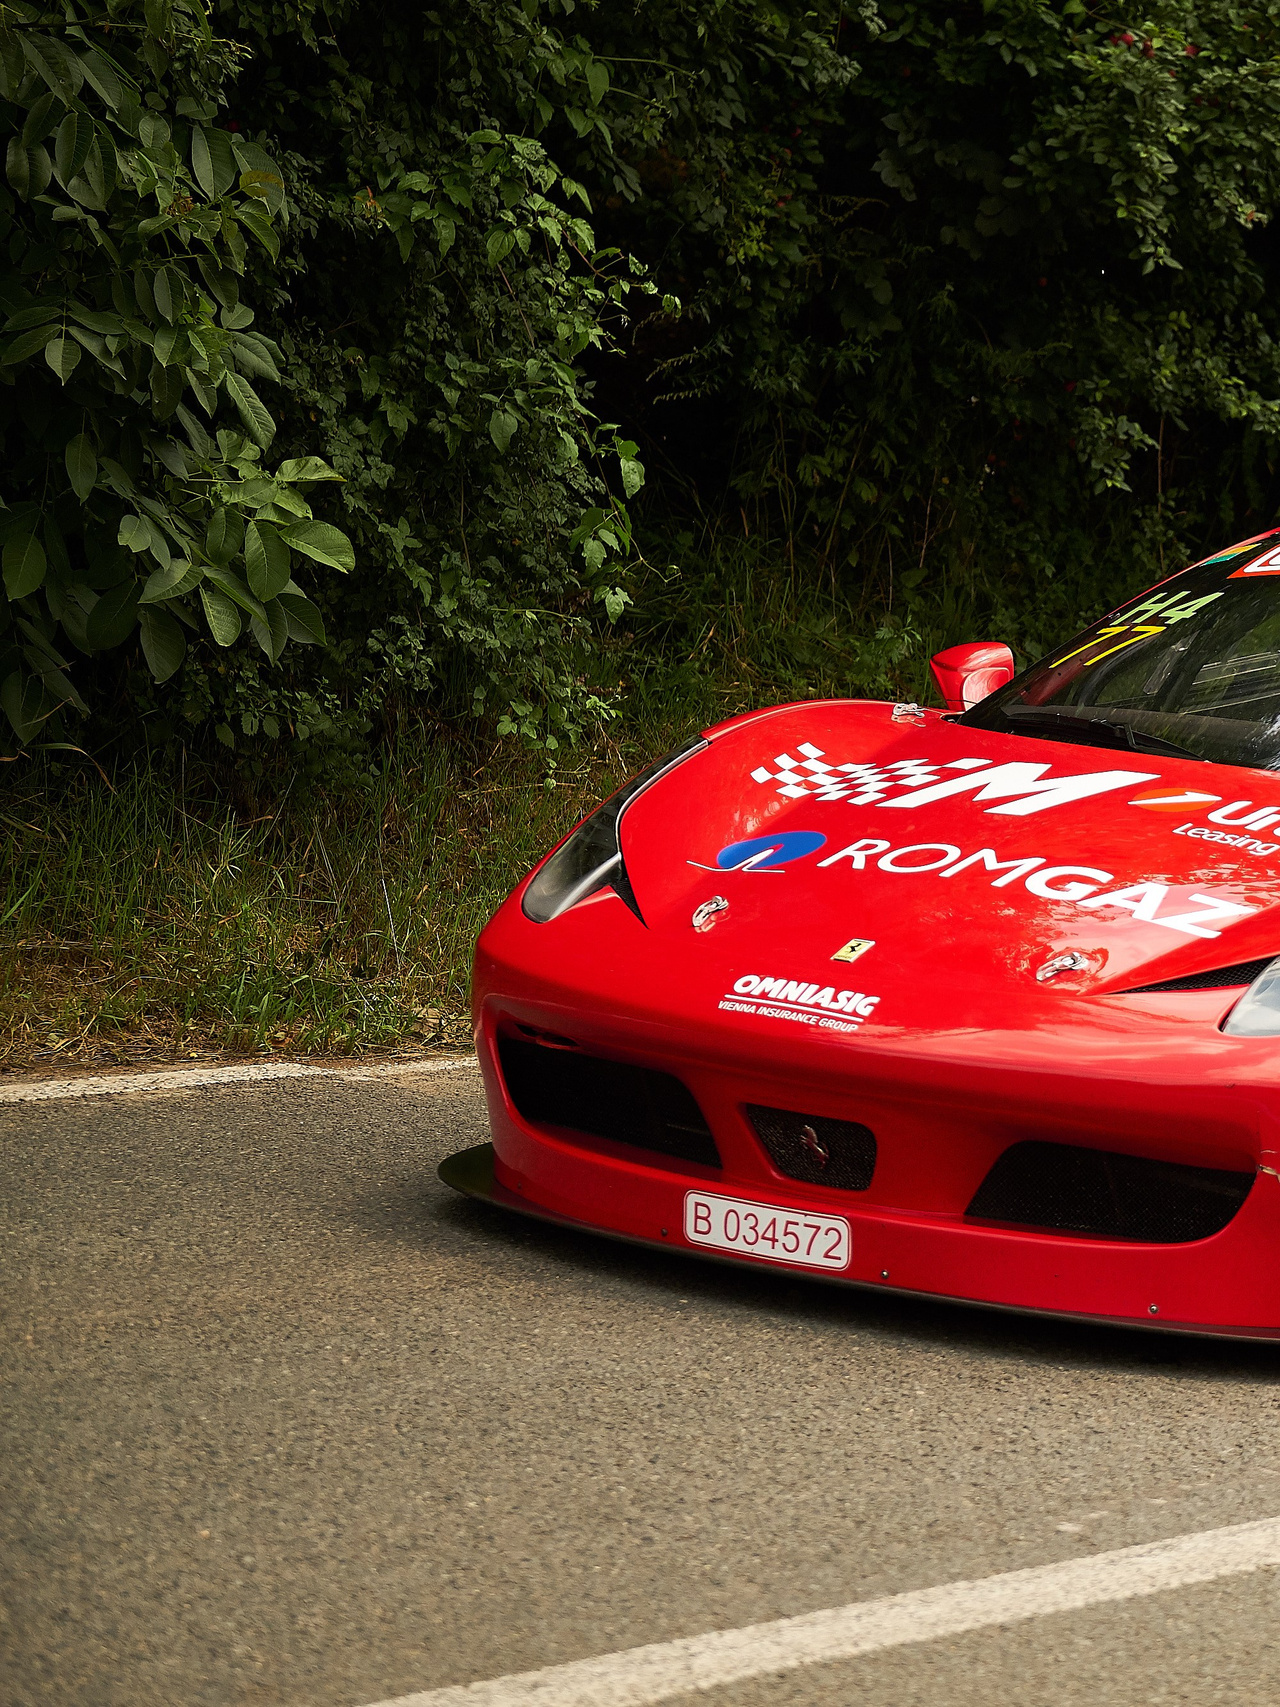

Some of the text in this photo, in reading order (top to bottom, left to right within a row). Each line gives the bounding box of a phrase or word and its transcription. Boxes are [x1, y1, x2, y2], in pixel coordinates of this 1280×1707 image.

[1109, 590, 1225, 625] H4
[816, 838, 1257, 939] ROMGAZ
[718, 1000, 859, 1032] VIENNA INSURANCE GROUP
[733, 974, 881, 1017] OMNIASIG
[694, 1202, 844, 1262] B 034572
